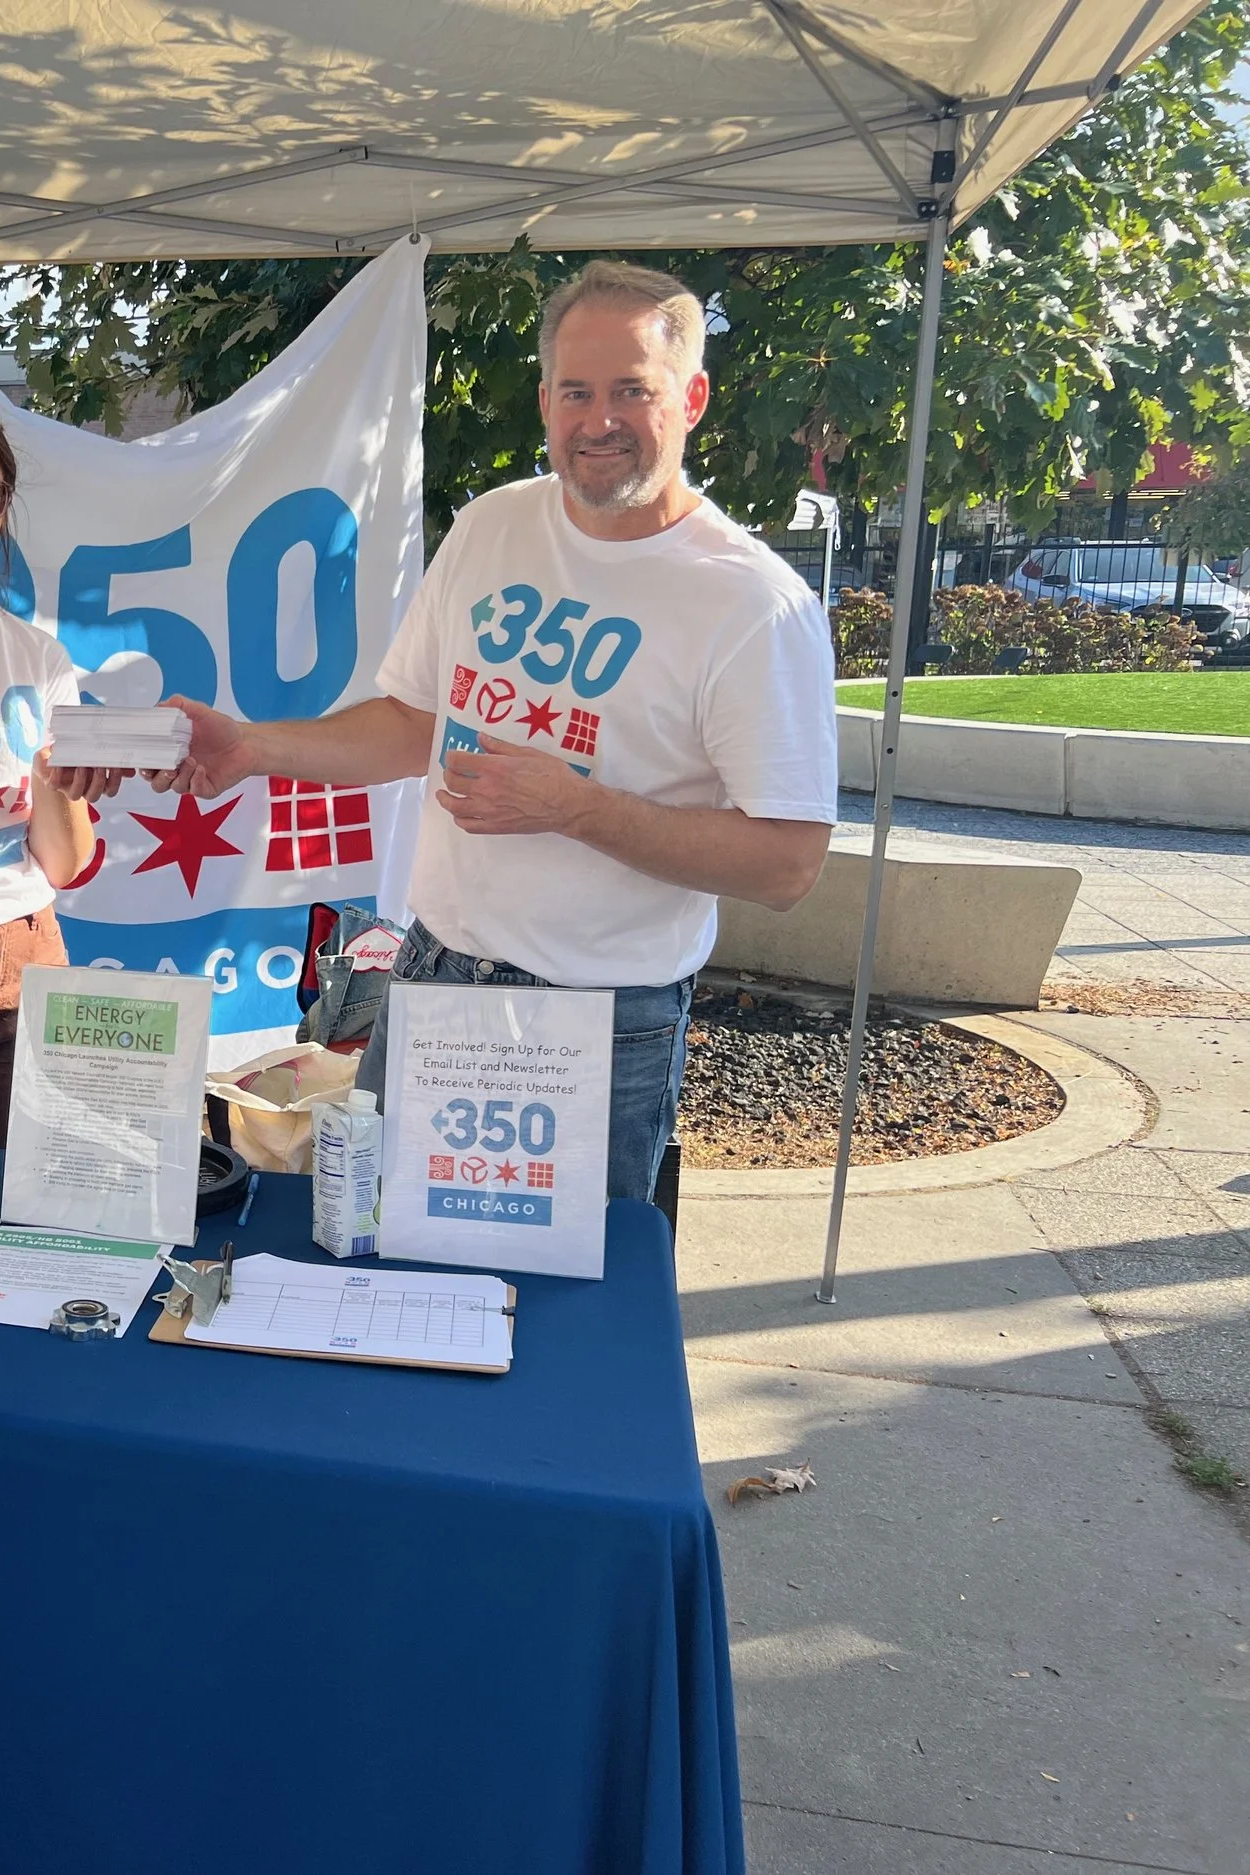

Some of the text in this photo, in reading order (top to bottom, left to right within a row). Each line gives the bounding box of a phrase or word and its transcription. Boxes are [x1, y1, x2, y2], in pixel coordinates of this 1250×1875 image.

[478, 584, 642, 699] 350
[91, 998, 110, 1006] SAFE
[75, 1005, 146, 1026] ENERGY
[54, 1025, 164, 1051] EVERYONE
[413, 1039, 581, 1057] Get Involved! Sign Up for Our
[54, 1050, 78, 1060] Chicago
[108, 1055, 124, 1064] Utility
[126, 1057, 167, 1068] Accountability
[89, 1062, 118, 1071] Campaign
[423, 1057, 569, 1075] Email List and Newsletter
[415, 1076, 577, 1095] To Receive Periodic Updates!
[443, 1098, 556, 1156] 350
[443, 1197, 535, 1215] CHICAGO
[26, 1239, 111, 1252] AFFORDABILITY
